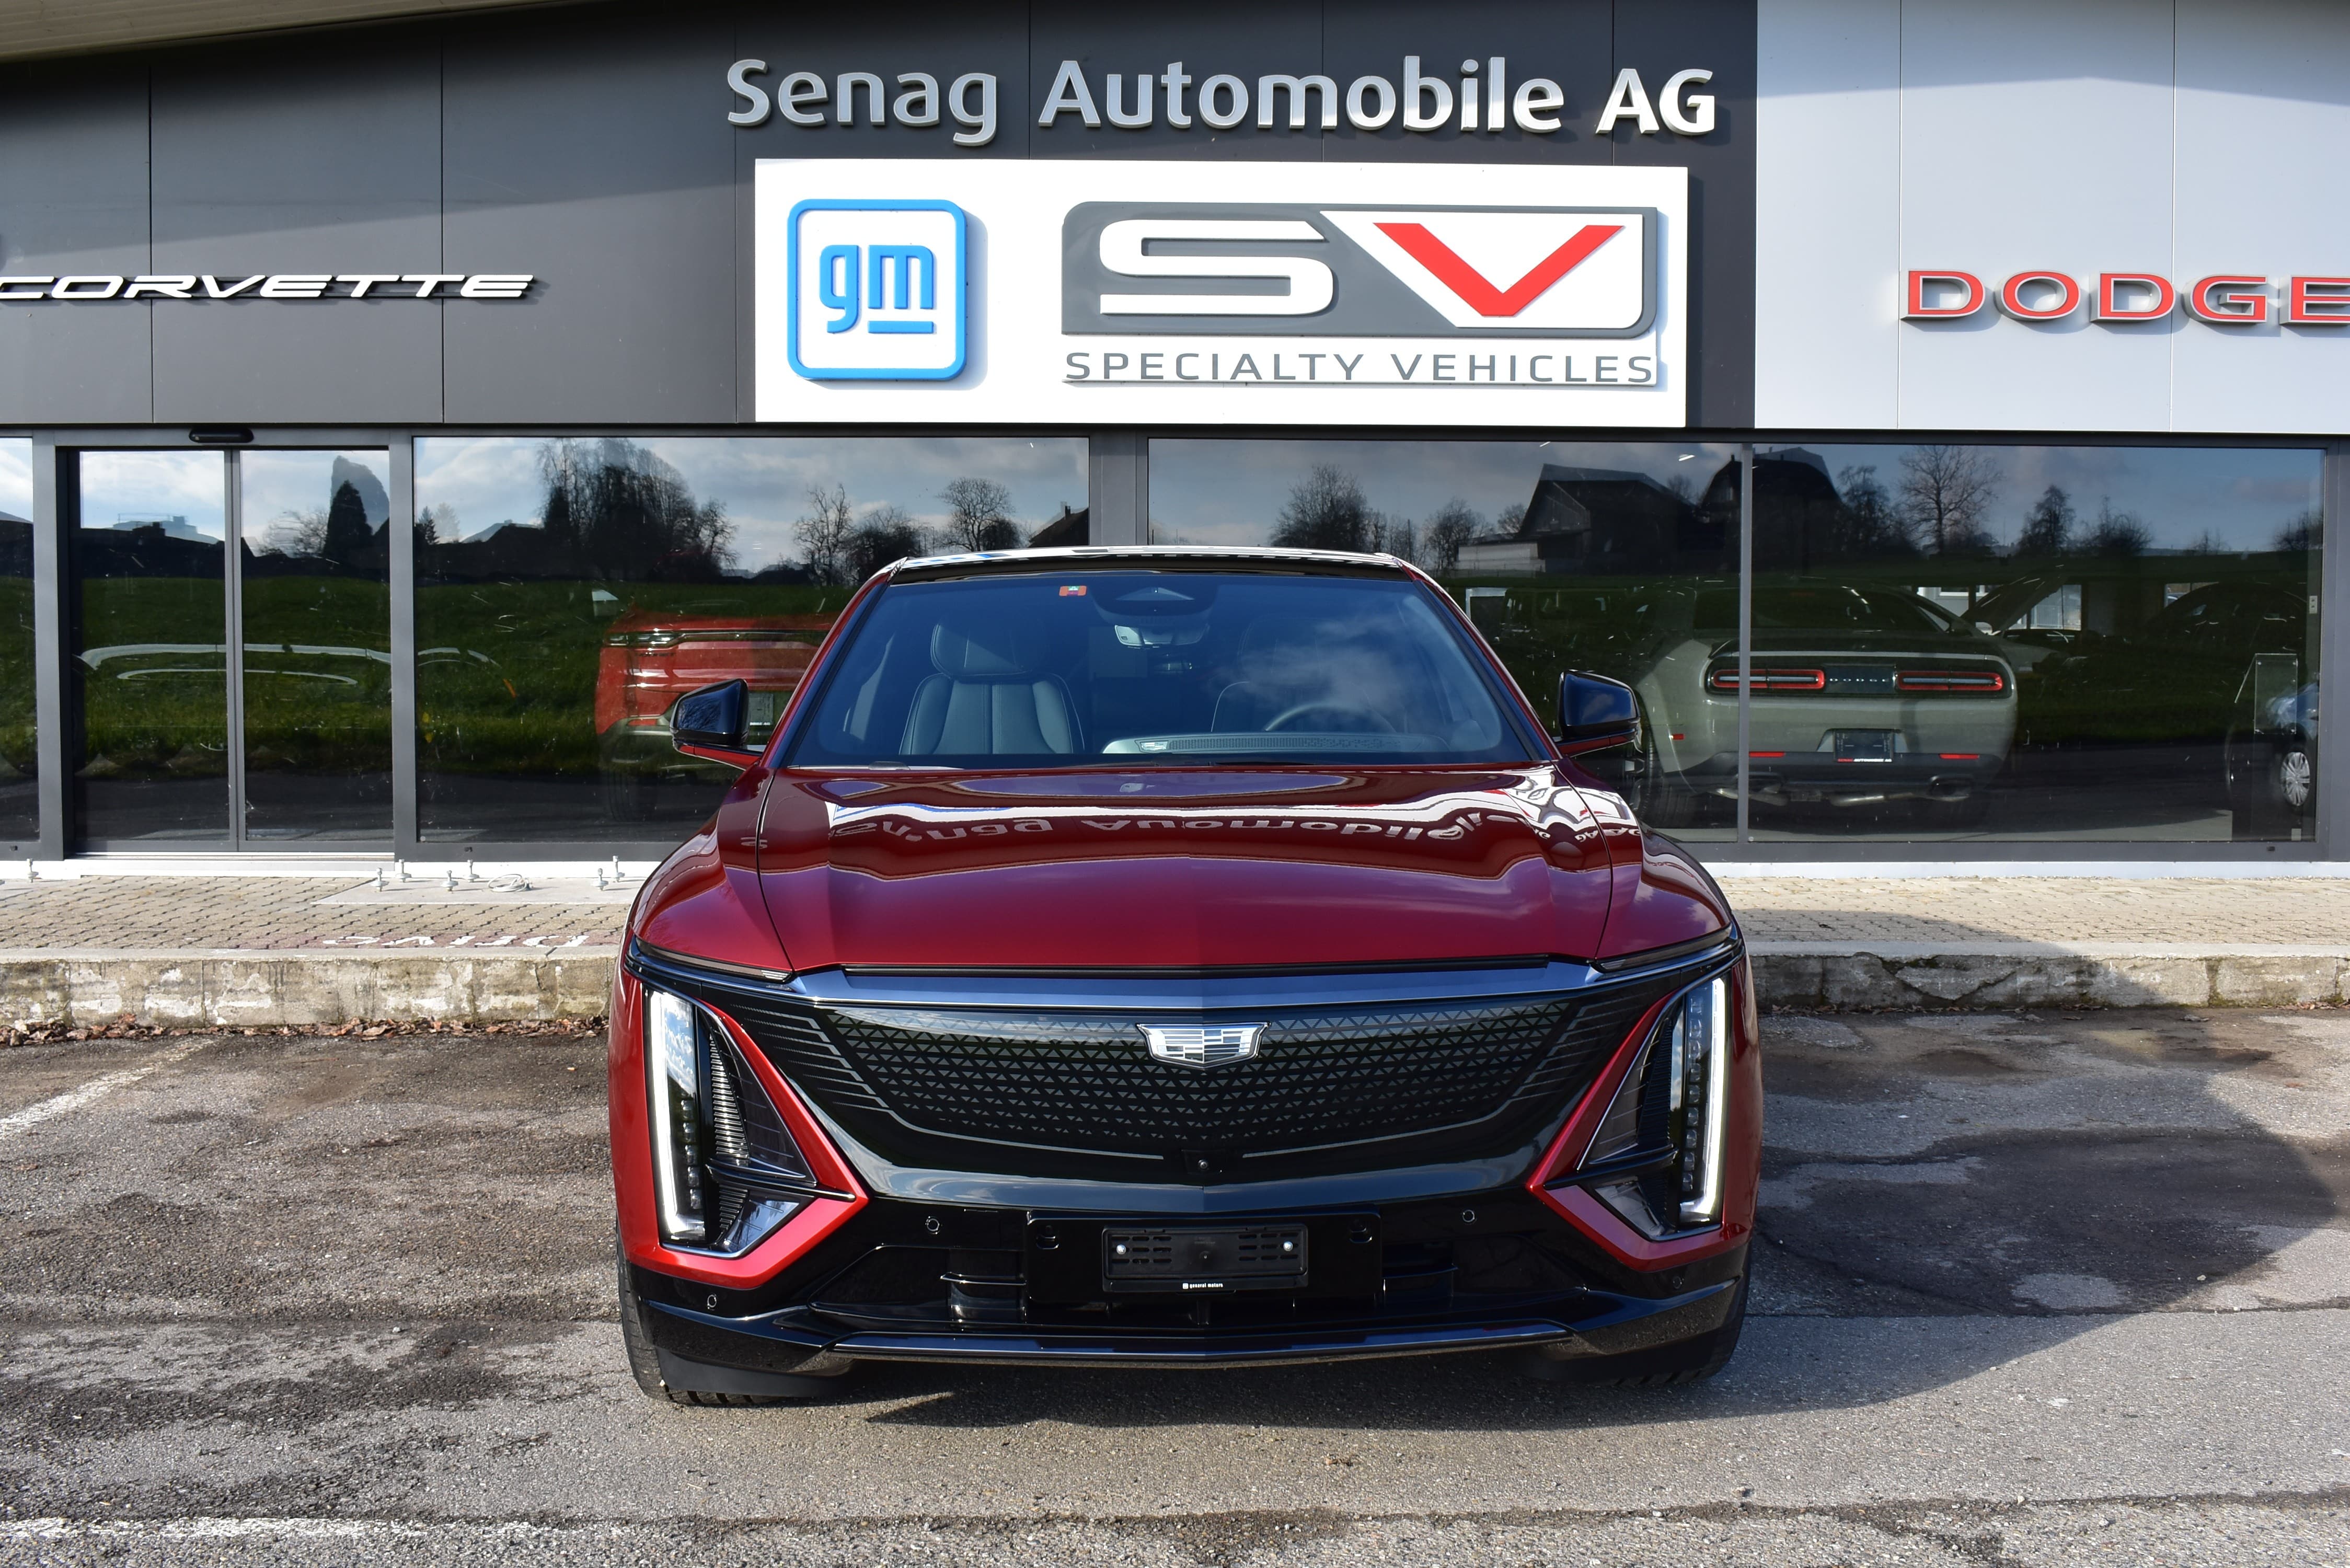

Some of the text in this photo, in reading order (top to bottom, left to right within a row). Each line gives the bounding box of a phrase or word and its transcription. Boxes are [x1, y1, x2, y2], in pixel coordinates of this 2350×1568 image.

[727, 56, 1715, 146] Senag Automobile AG
[0, 274, 534, 299] CORVETTE
[819, 245, 934, 334] gm
[1902, 269, 2350, 326] DODGE
[1066, 352, 1652, 384] SPECIALTY VEHICLES
